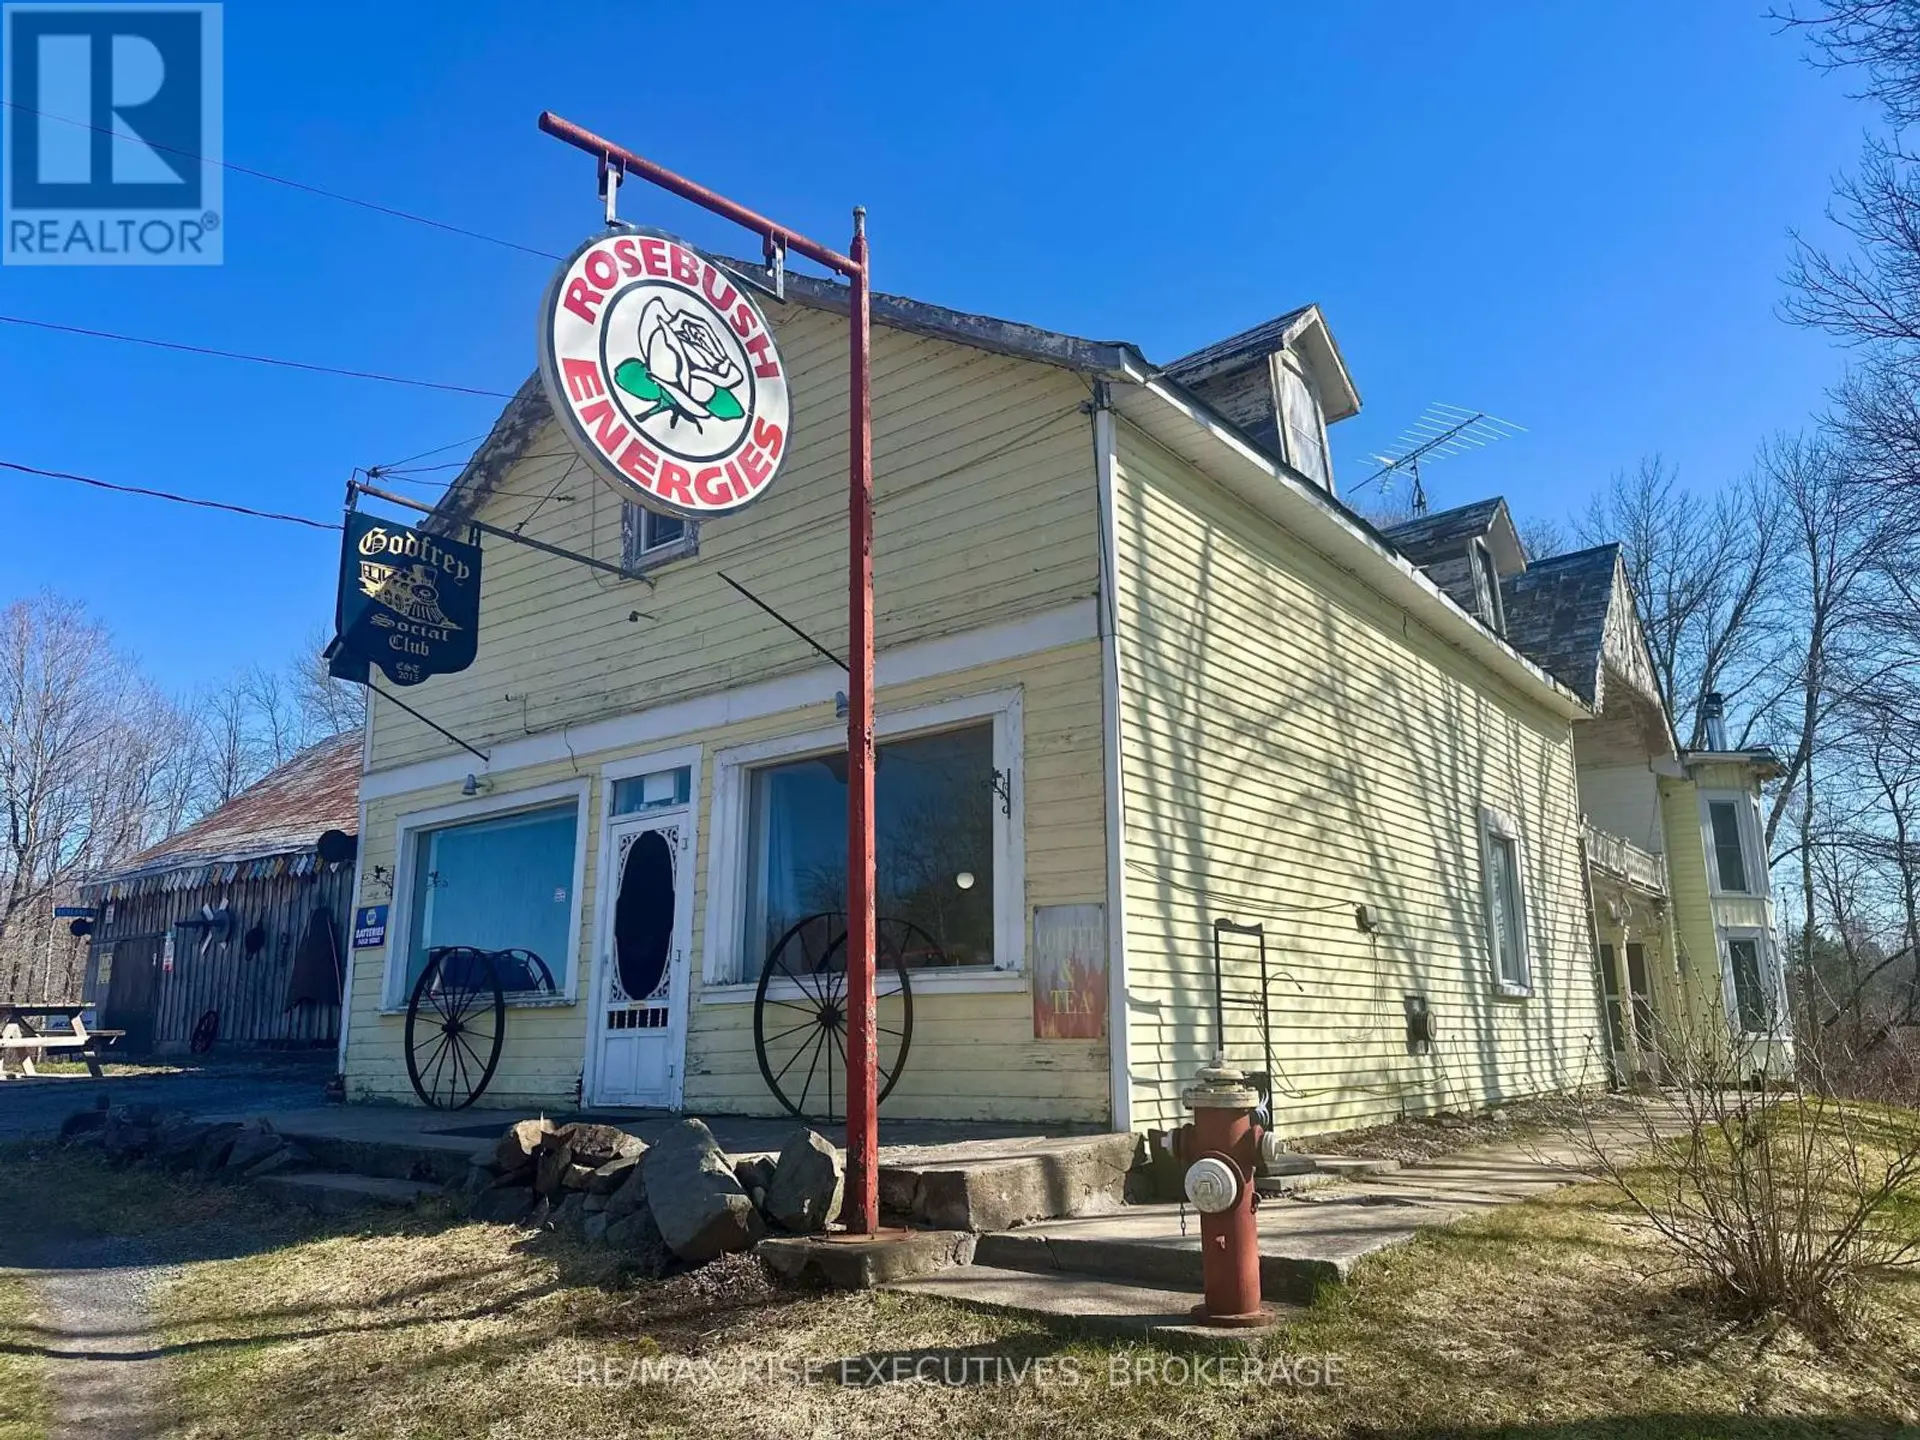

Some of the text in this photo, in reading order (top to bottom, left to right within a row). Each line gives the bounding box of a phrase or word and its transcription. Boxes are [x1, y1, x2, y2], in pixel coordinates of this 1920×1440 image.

[563, 238, 780, 380] ROSEBUSH
[562, 357, 784, 506] ENERGIES
[358, 526, 470, 586] Godfrey
[370, 613, 450, 642] Social
[388, 633, 430, 657] Club
[1050, 990, 1092, 1014] TEA
